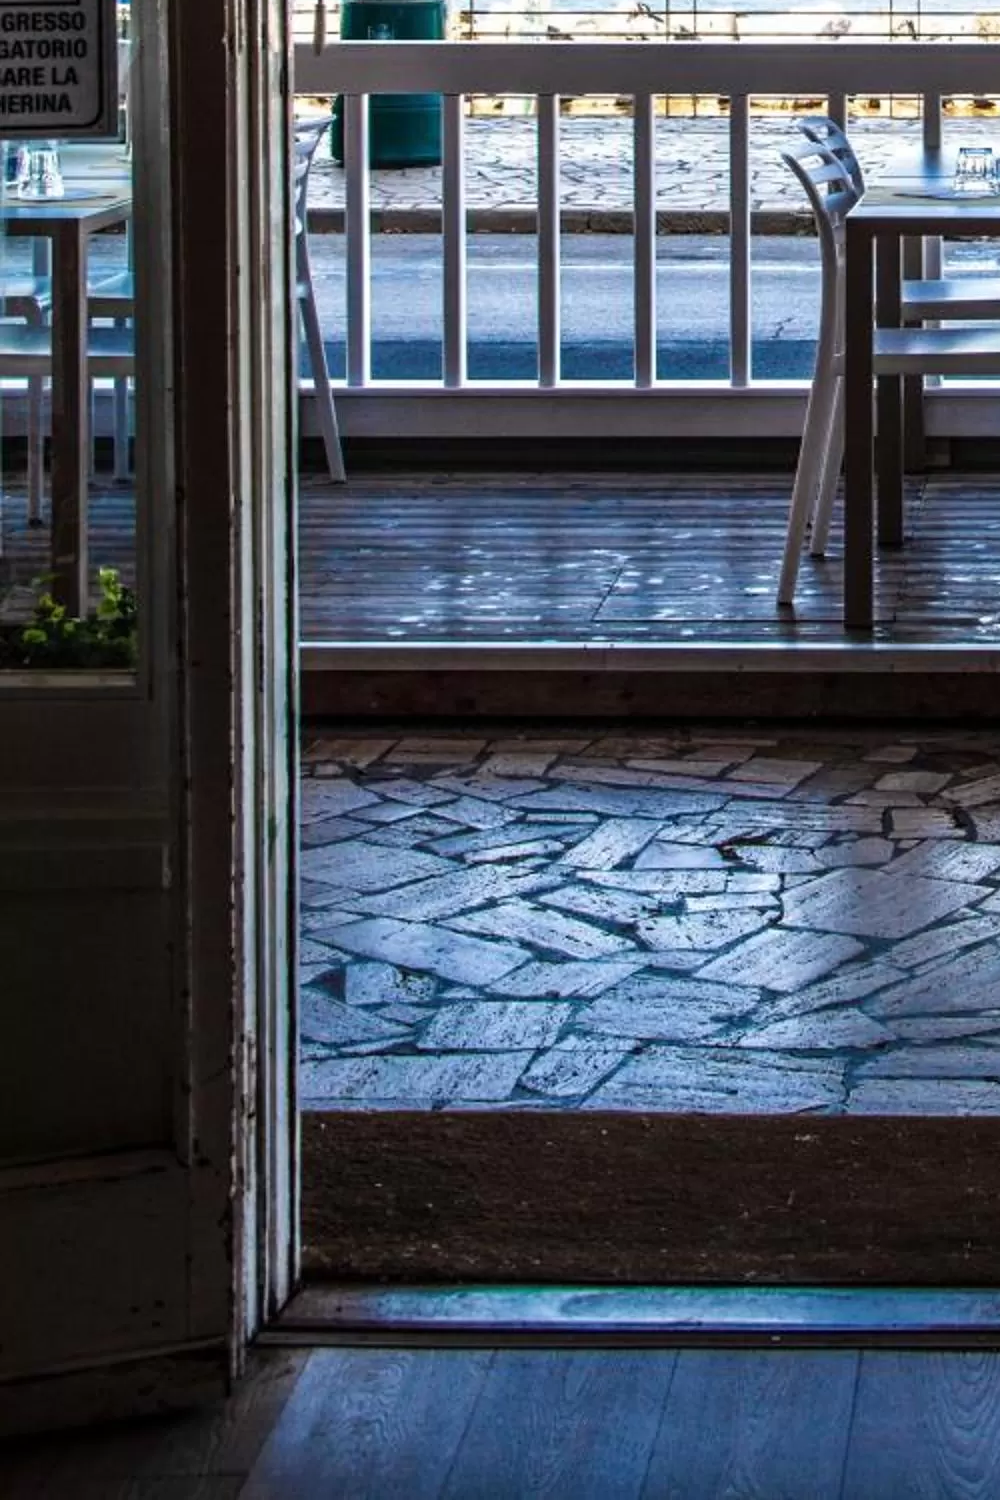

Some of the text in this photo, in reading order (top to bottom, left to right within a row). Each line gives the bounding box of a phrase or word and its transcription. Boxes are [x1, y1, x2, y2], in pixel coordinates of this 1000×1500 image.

[1, 11, 87, 32] GRESSO
[0, 65, 79, 86] ARE LA
